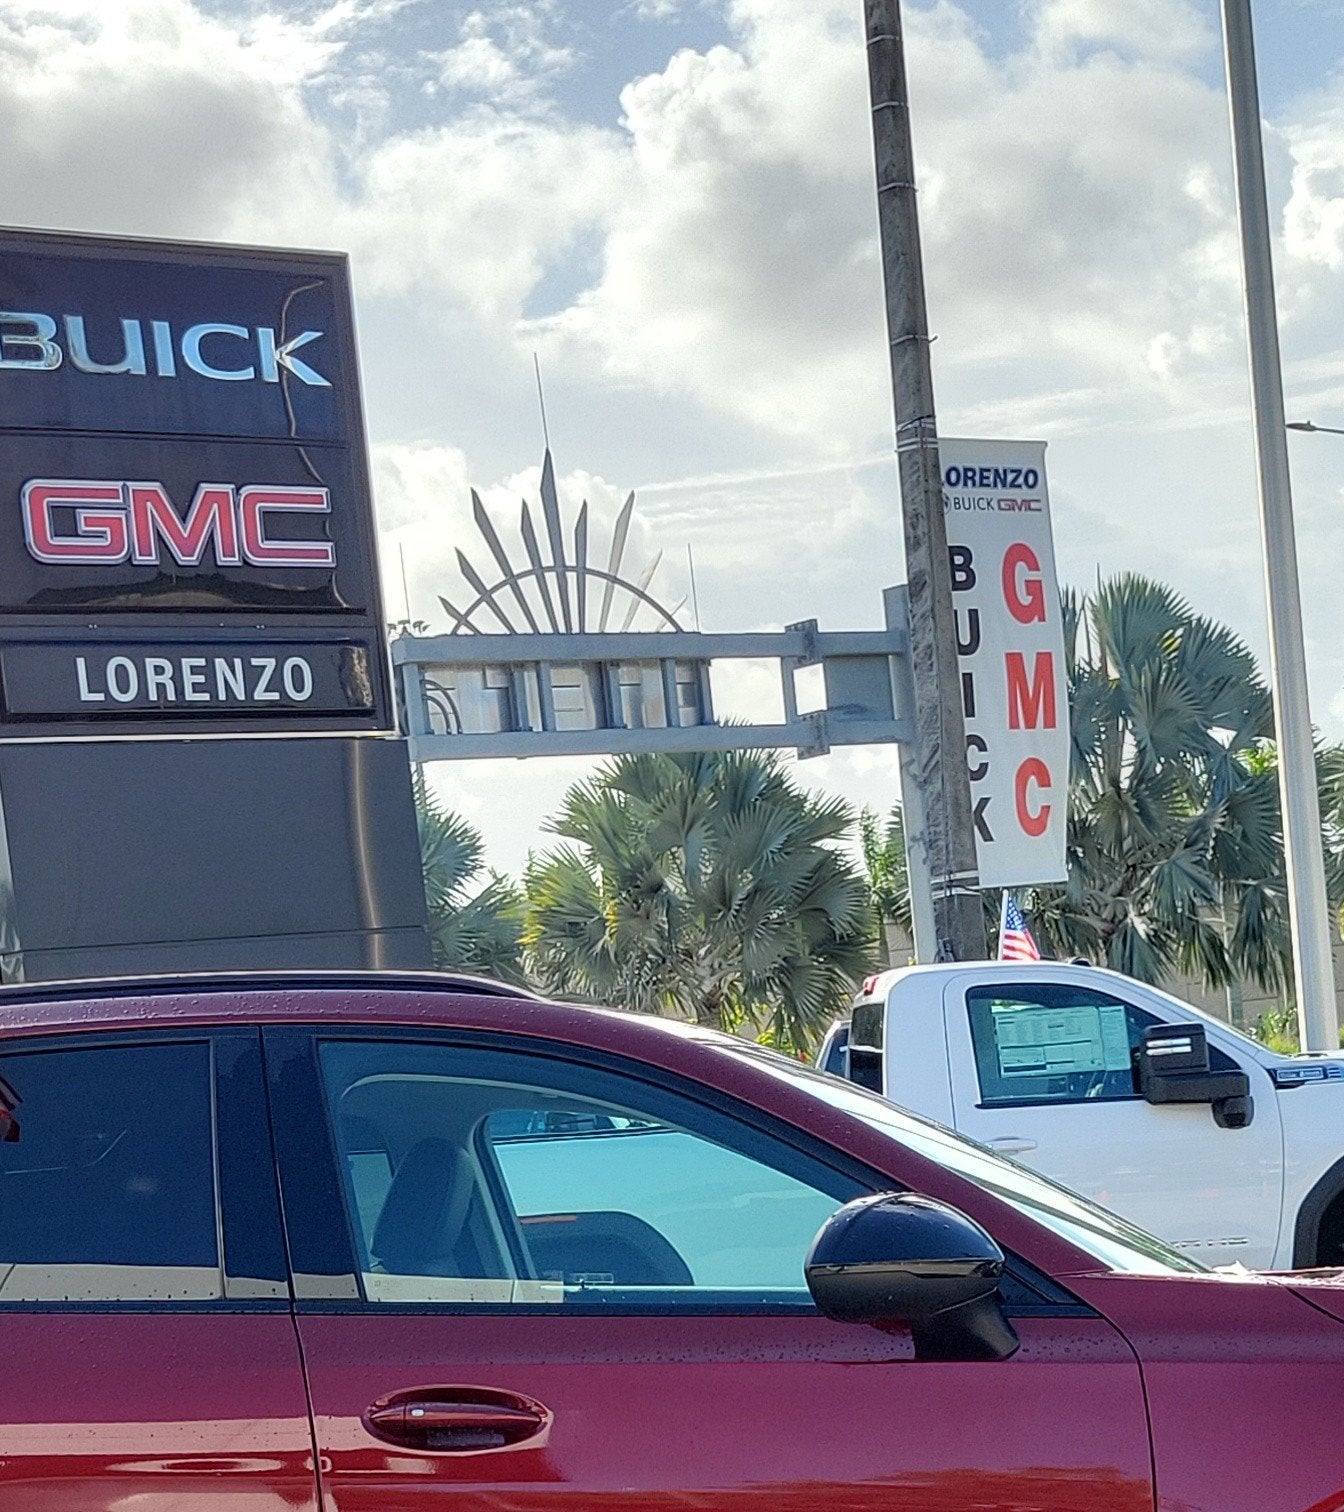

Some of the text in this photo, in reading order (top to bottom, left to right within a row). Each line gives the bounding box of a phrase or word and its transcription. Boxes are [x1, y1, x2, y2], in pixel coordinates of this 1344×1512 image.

[944, 466, 1039, 489] ORENZO
[953, 496, 1042, 512] BUICK GMC
[22, 478, 338, 568] GMC
[76, 656, 313, 702] LORENZO
[948, 545, 995, 842] BUICK
[1002, 542, 1056, 837] GMC
